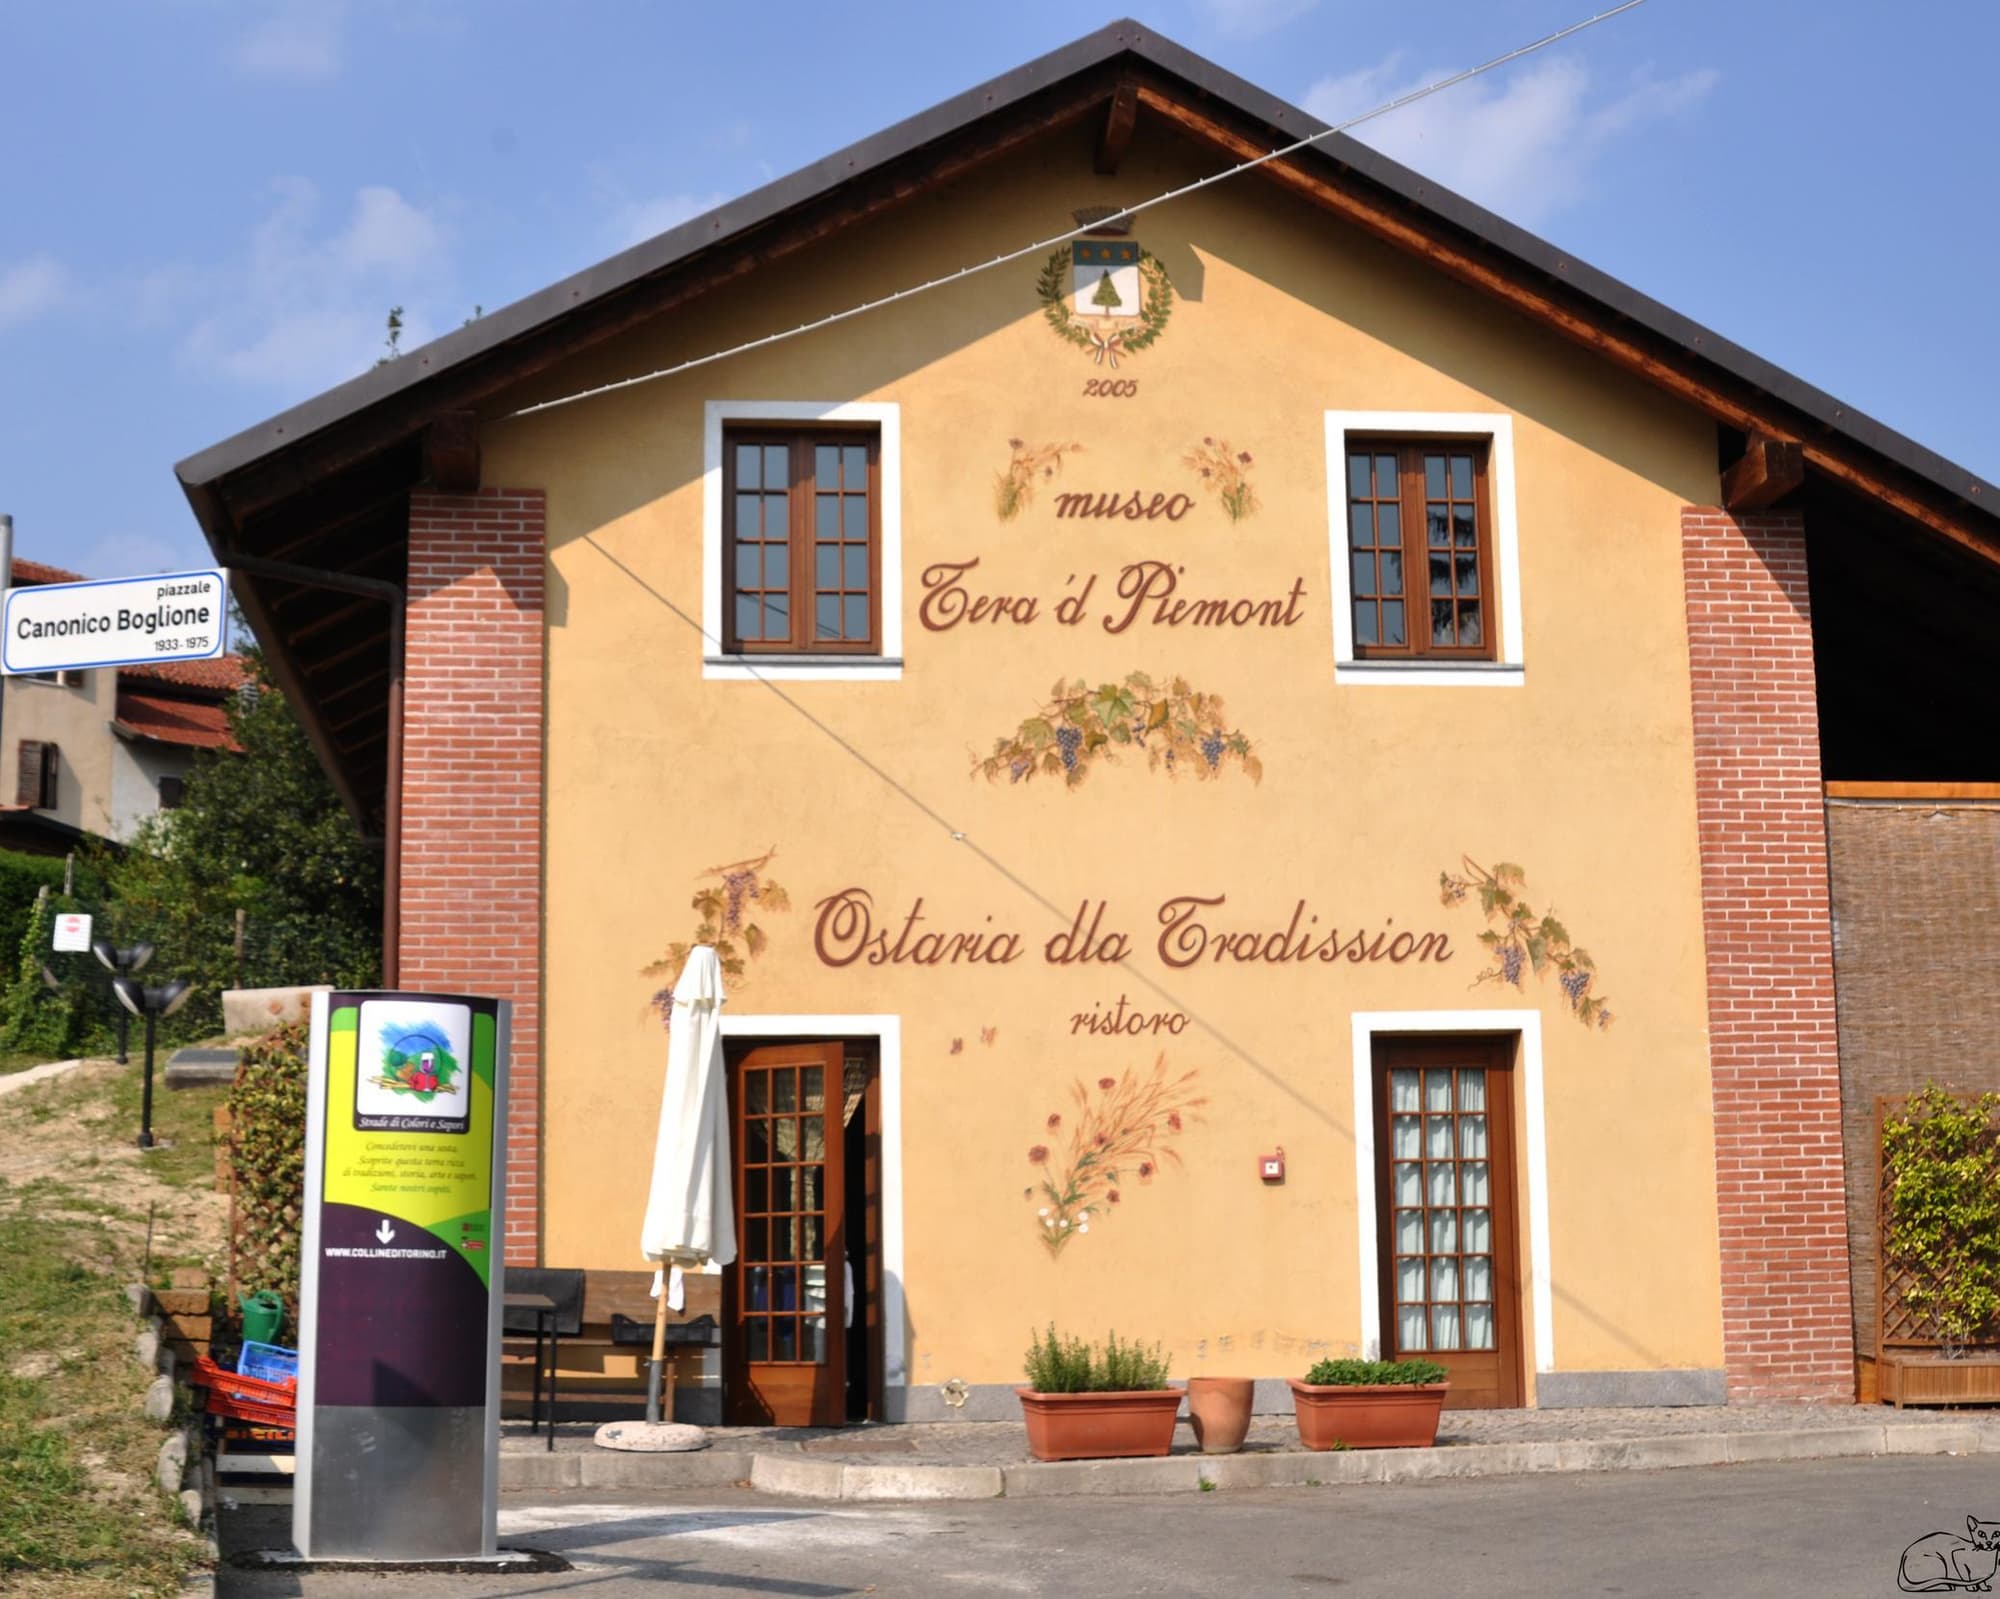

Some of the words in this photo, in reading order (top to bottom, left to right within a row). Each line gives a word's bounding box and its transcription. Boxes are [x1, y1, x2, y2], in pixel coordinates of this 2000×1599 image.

[1082, 378, 1138, 397] 2005
[1053, 490, 1195, 520] museo
[157, 581, 210, 599] piazzale
[919, 557, 1040, 631] Tera
[1102, 560, 1307, 633] Piemont
[17, 613, 111, 639] Canonico
[117, 605, 210, 634] Boglione
[814, 887, 1023, 967] Ostaria
[1045, 900, 1131, 964] dla
[1157, 894, 1453, 968] Tradission
[1070, 994, 1190, 1035] ristoro
[359, 1117, 388, 1127] Strade
[389, 1117, 400, 1127] di
[401, 1118, 430, 1129] Colori
[438, 1120, 464, 1132] Sapori
[324, 1248, 447, 1259] WWW.COLLINEDITORINO.IT
